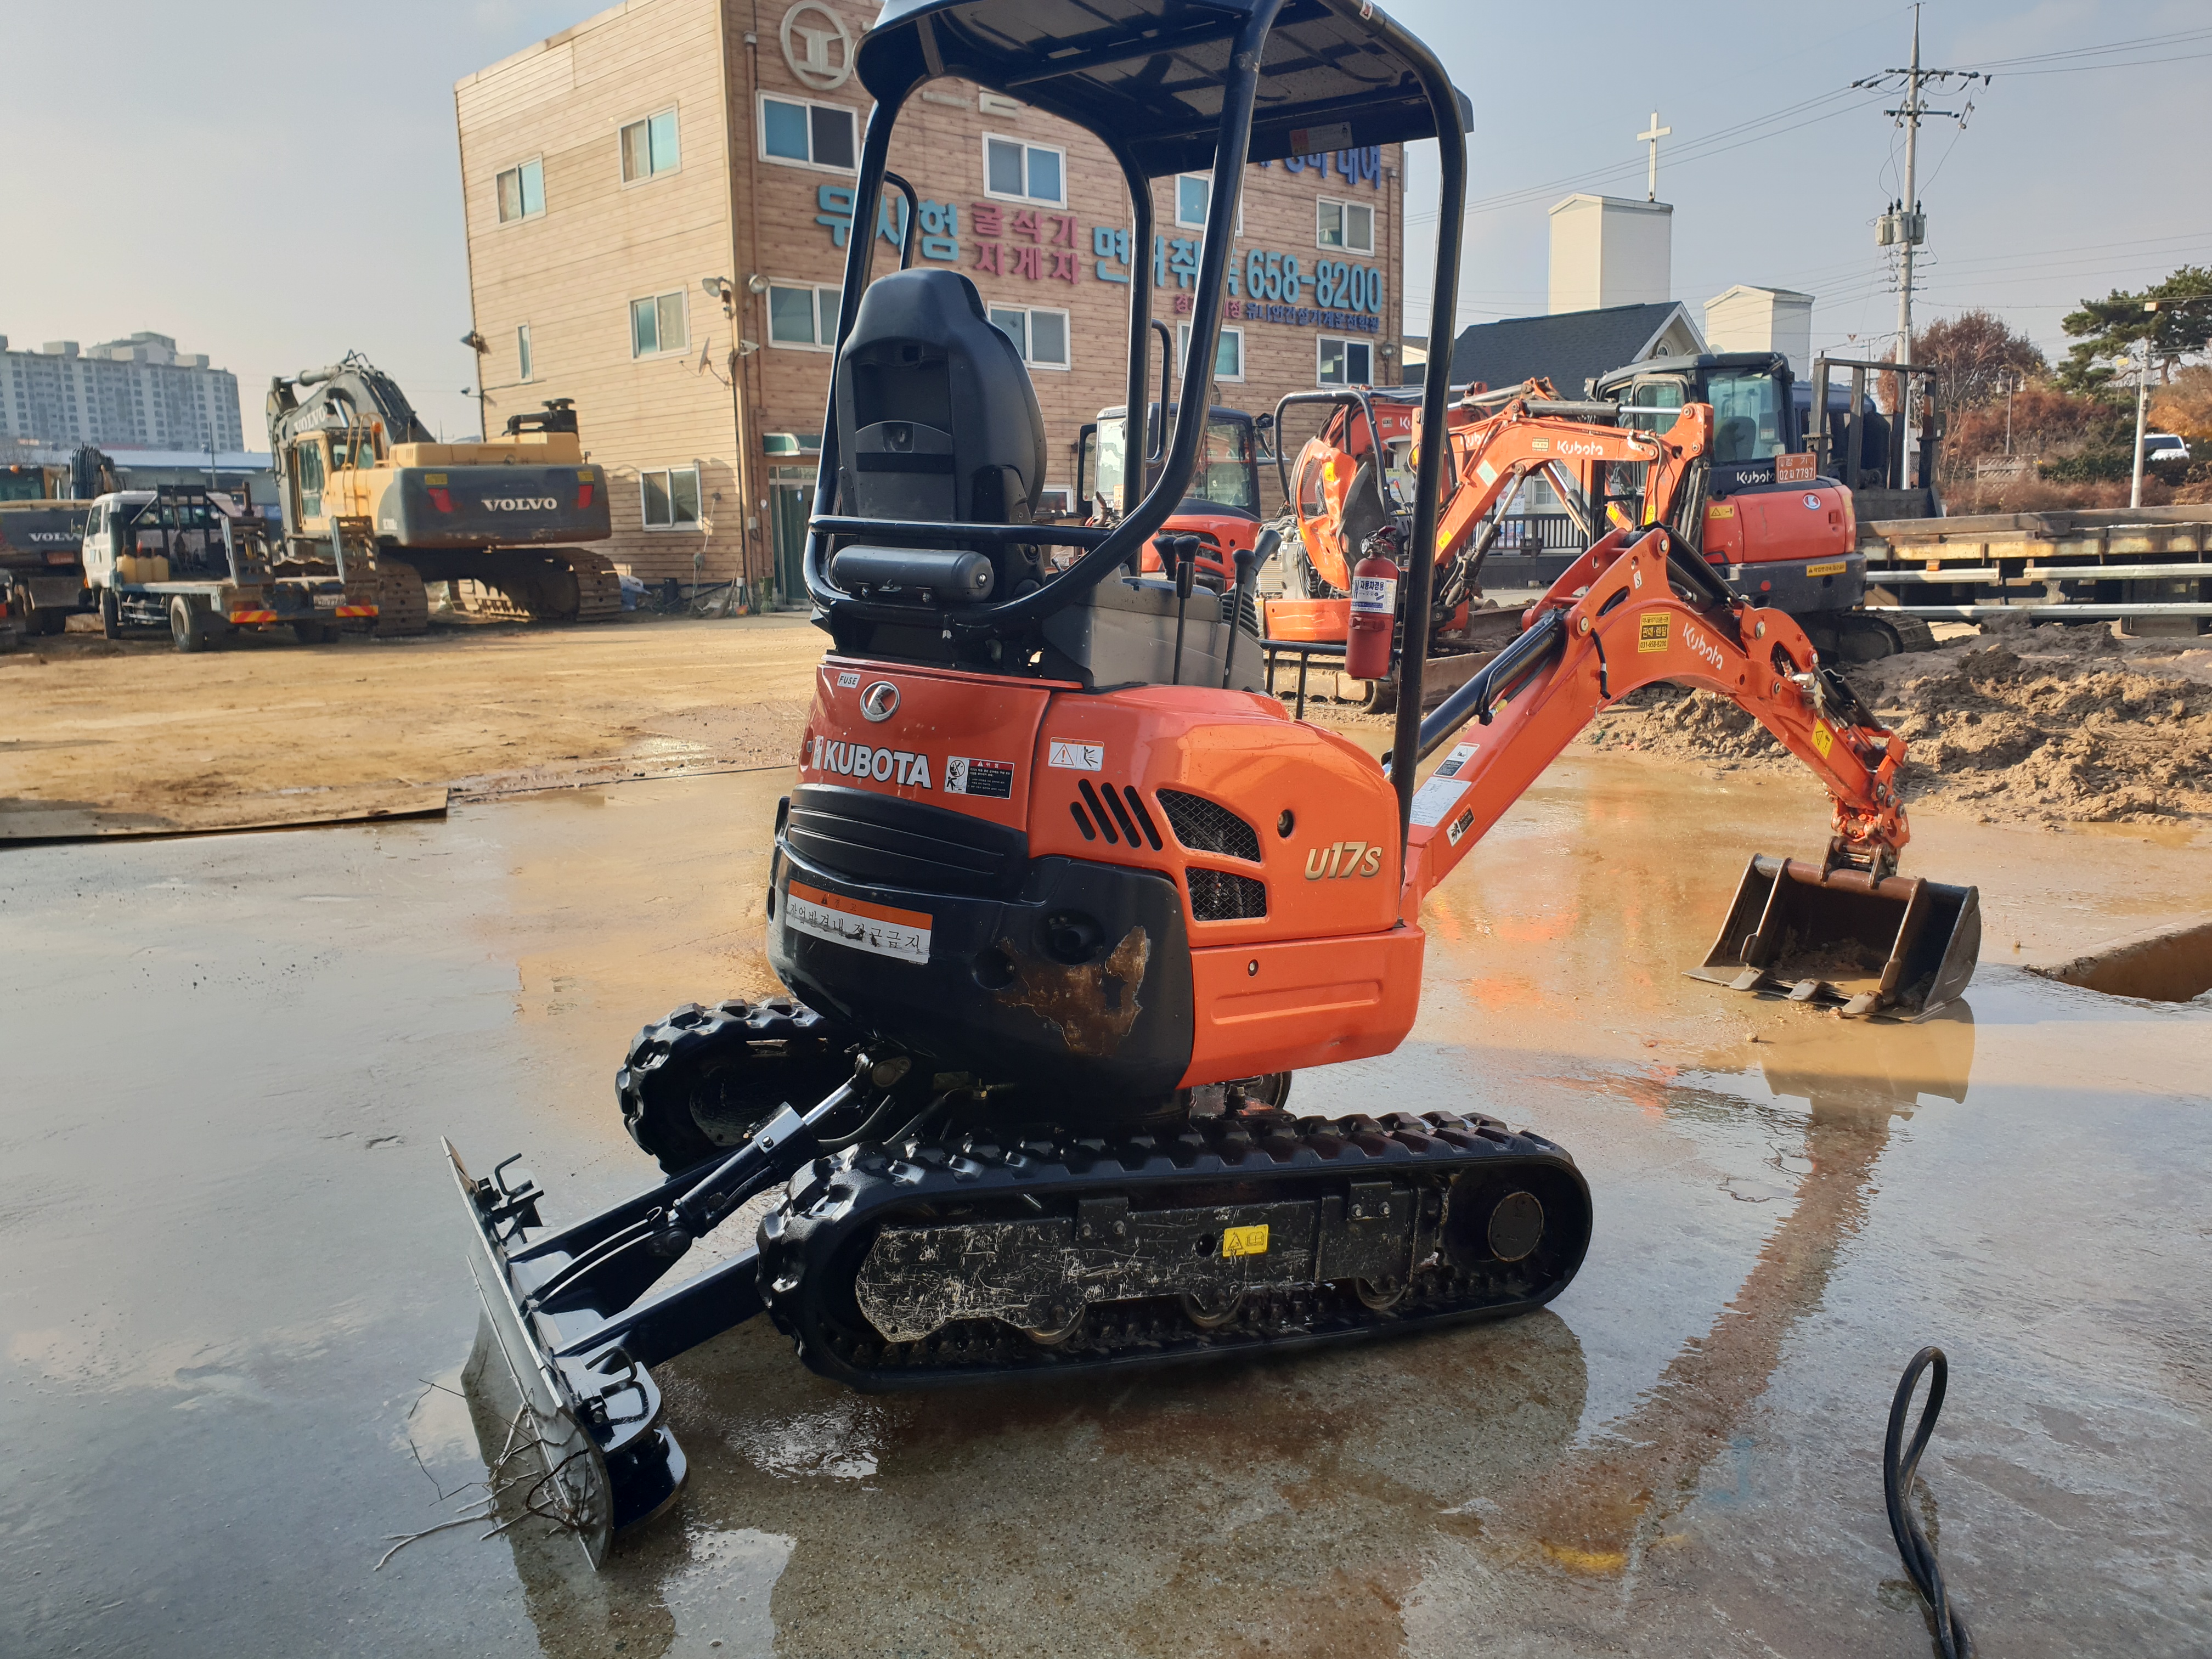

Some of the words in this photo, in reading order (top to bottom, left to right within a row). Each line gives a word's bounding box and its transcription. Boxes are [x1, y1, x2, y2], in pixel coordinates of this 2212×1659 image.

[814, 185, 960, 261] 무시험
[972, 202, 1078, 249] 굴삭기
[974, 241, 1082, 285] 지게차
[1246, 249, 1383, 314] 658-8200
[294, 405, 326, 433] VOLVO
[1557, 440, 1603, 456] Kubota
[481, 497, 558, 511] VOLVO
[1360, 580, 1384, 591] 자동차겸용
[1640, 640, 1667, 648] 031-658-8200
[1683, 622, 1723, 670] Kubota
[839, 675, 857, 685] FUSE
[823, 739, 933, 790] KUBOTA
